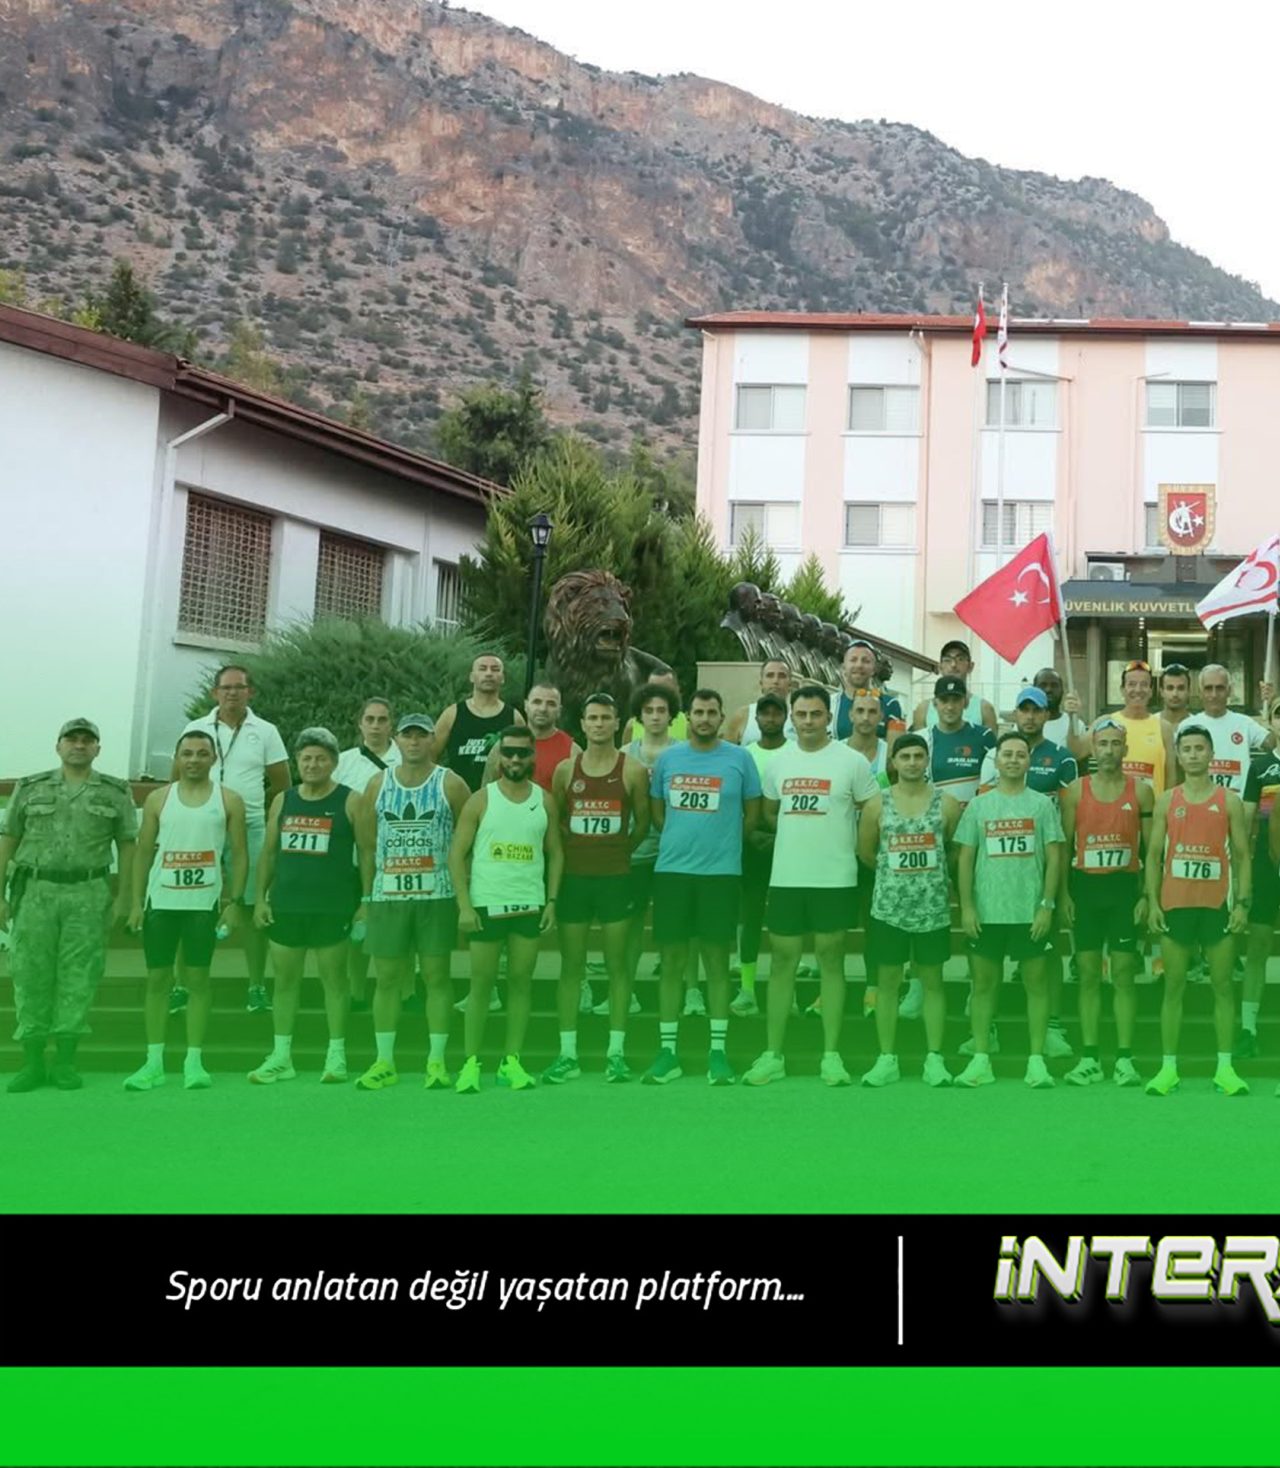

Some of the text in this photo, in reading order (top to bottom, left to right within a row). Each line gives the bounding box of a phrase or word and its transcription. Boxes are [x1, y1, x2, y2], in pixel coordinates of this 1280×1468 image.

[1064, 600, 1124, 612] ÜVENLİK
[1129, 602, 1193, 612] KUVVETL
[458, 745, 486, 755] KEEP
[680, 792, 709, 809] 203
[791, 795, 819, 811] 202
[582, 817, 610, 834] 179
[288, 833, 318, 850] 211
[385, 835, 433, 848] adidas
[507, 844, 533, 853] CHINA
[998, 836, 1027, 853] 175
[899, 851, 928, 868] 200
[1097, 849, 1124, 866] 177
[173, 868, 205, 886] 182
[1184, 861, 1211, 878] 176
[394, 874, 422, 890] 181
